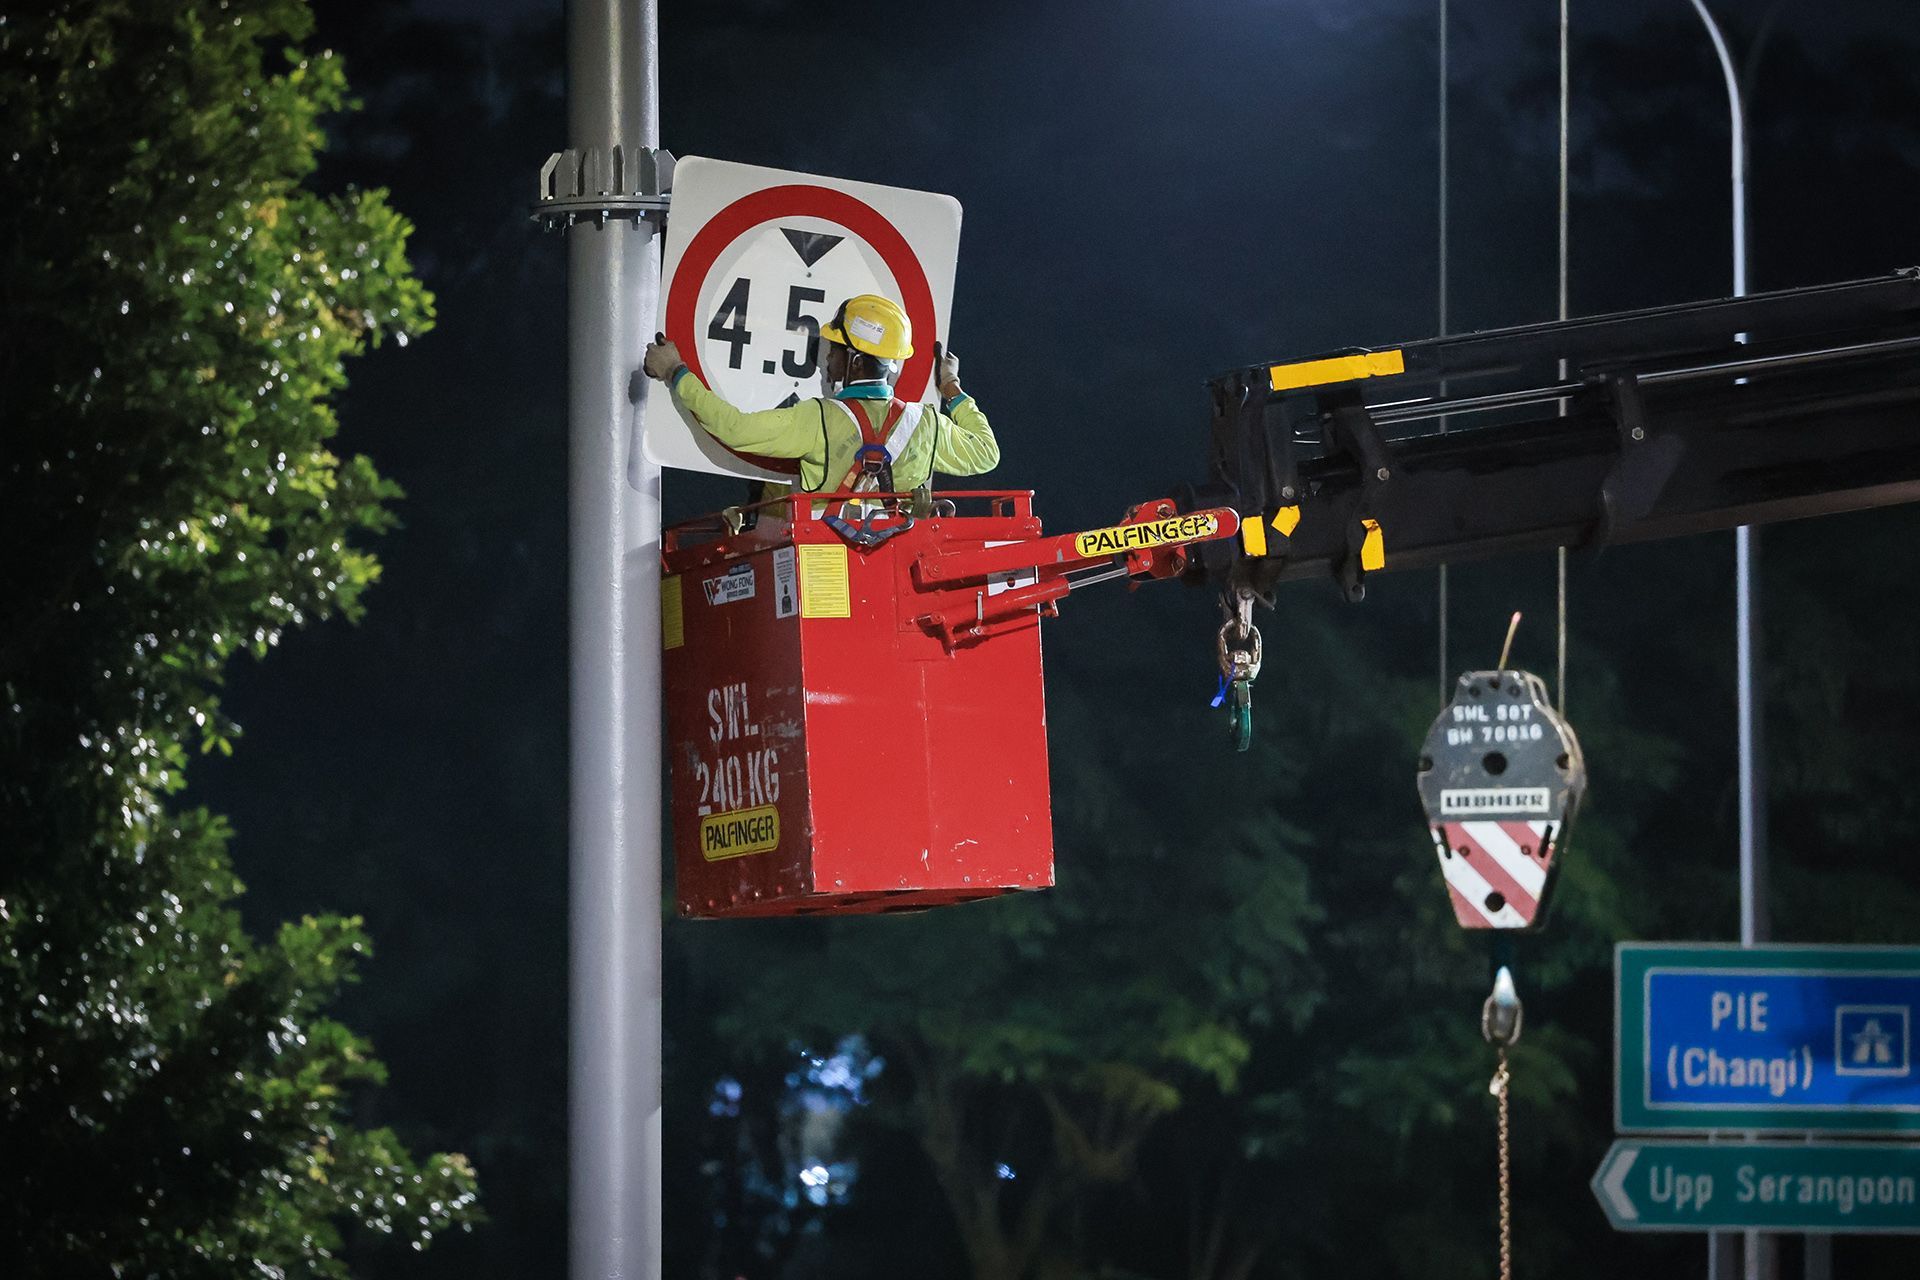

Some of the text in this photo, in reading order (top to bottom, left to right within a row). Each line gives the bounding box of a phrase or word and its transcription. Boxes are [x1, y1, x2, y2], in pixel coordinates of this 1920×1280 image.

[707, 277, 825, 379] 4.5
[1082, 513, 1211, 554] PALFINGER
[708, 682, 759, 743] SWL
[696, 749, 780, 817] 240 KG
[705, 815, 775, 851] PALFINGER
[1711, 991, 1768, 1032] PIE
[1667, 1045, 1814, 1098] (Changi)
[1649, 1164, 1916, 1214] Upp Serangoon
